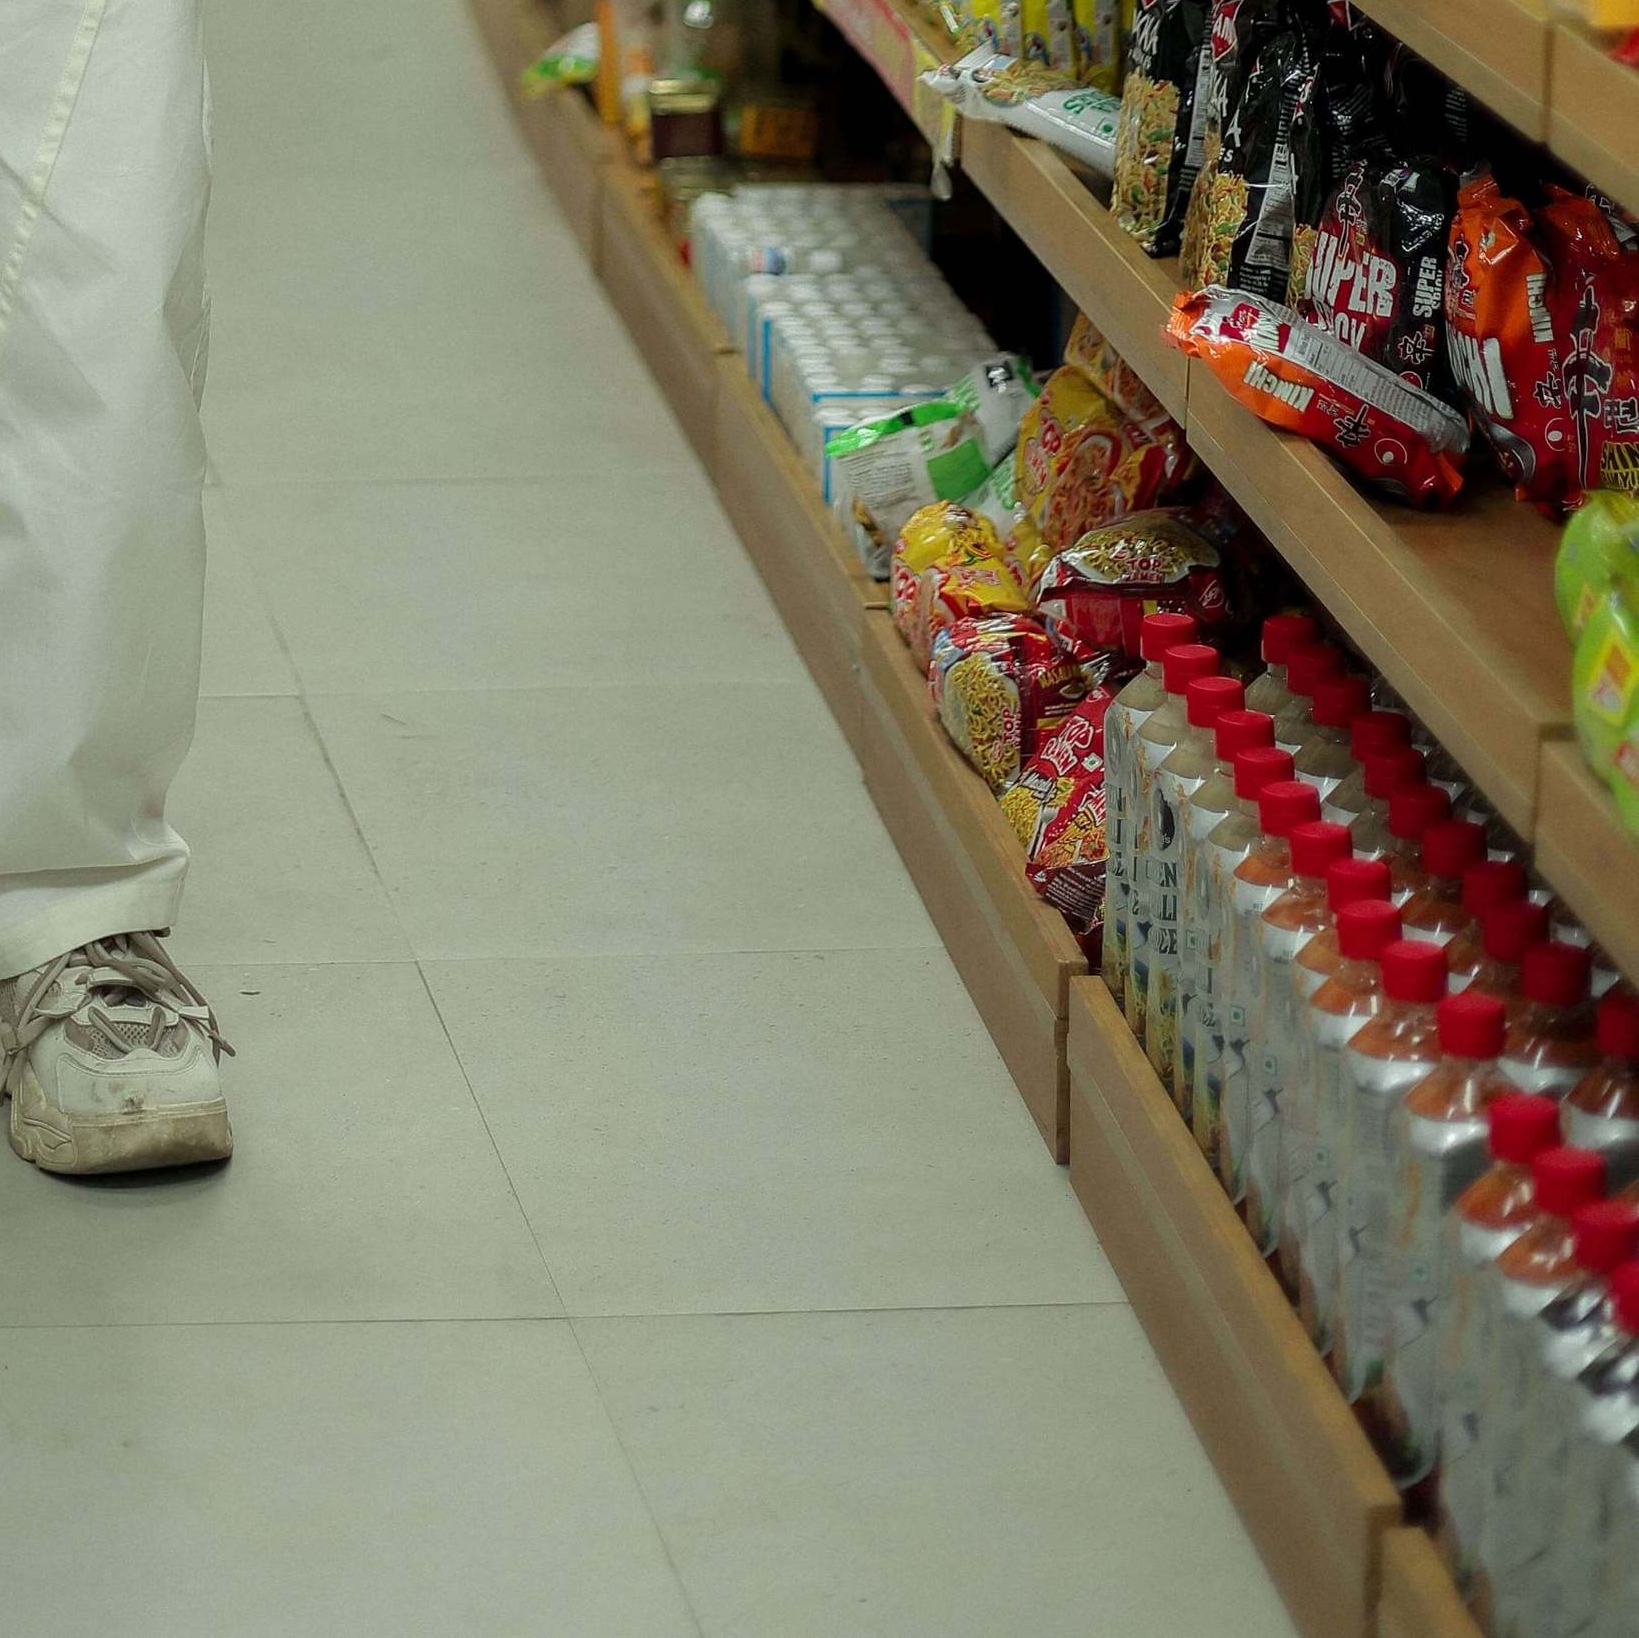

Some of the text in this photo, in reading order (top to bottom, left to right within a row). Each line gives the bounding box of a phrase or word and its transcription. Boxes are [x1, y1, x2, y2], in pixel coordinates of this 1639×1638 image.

[1412, 255, 1438, 320] SUPER
[1242, 359, 1315, 413] KIMCHI
[1125, 557, 1163, 571] TOP
